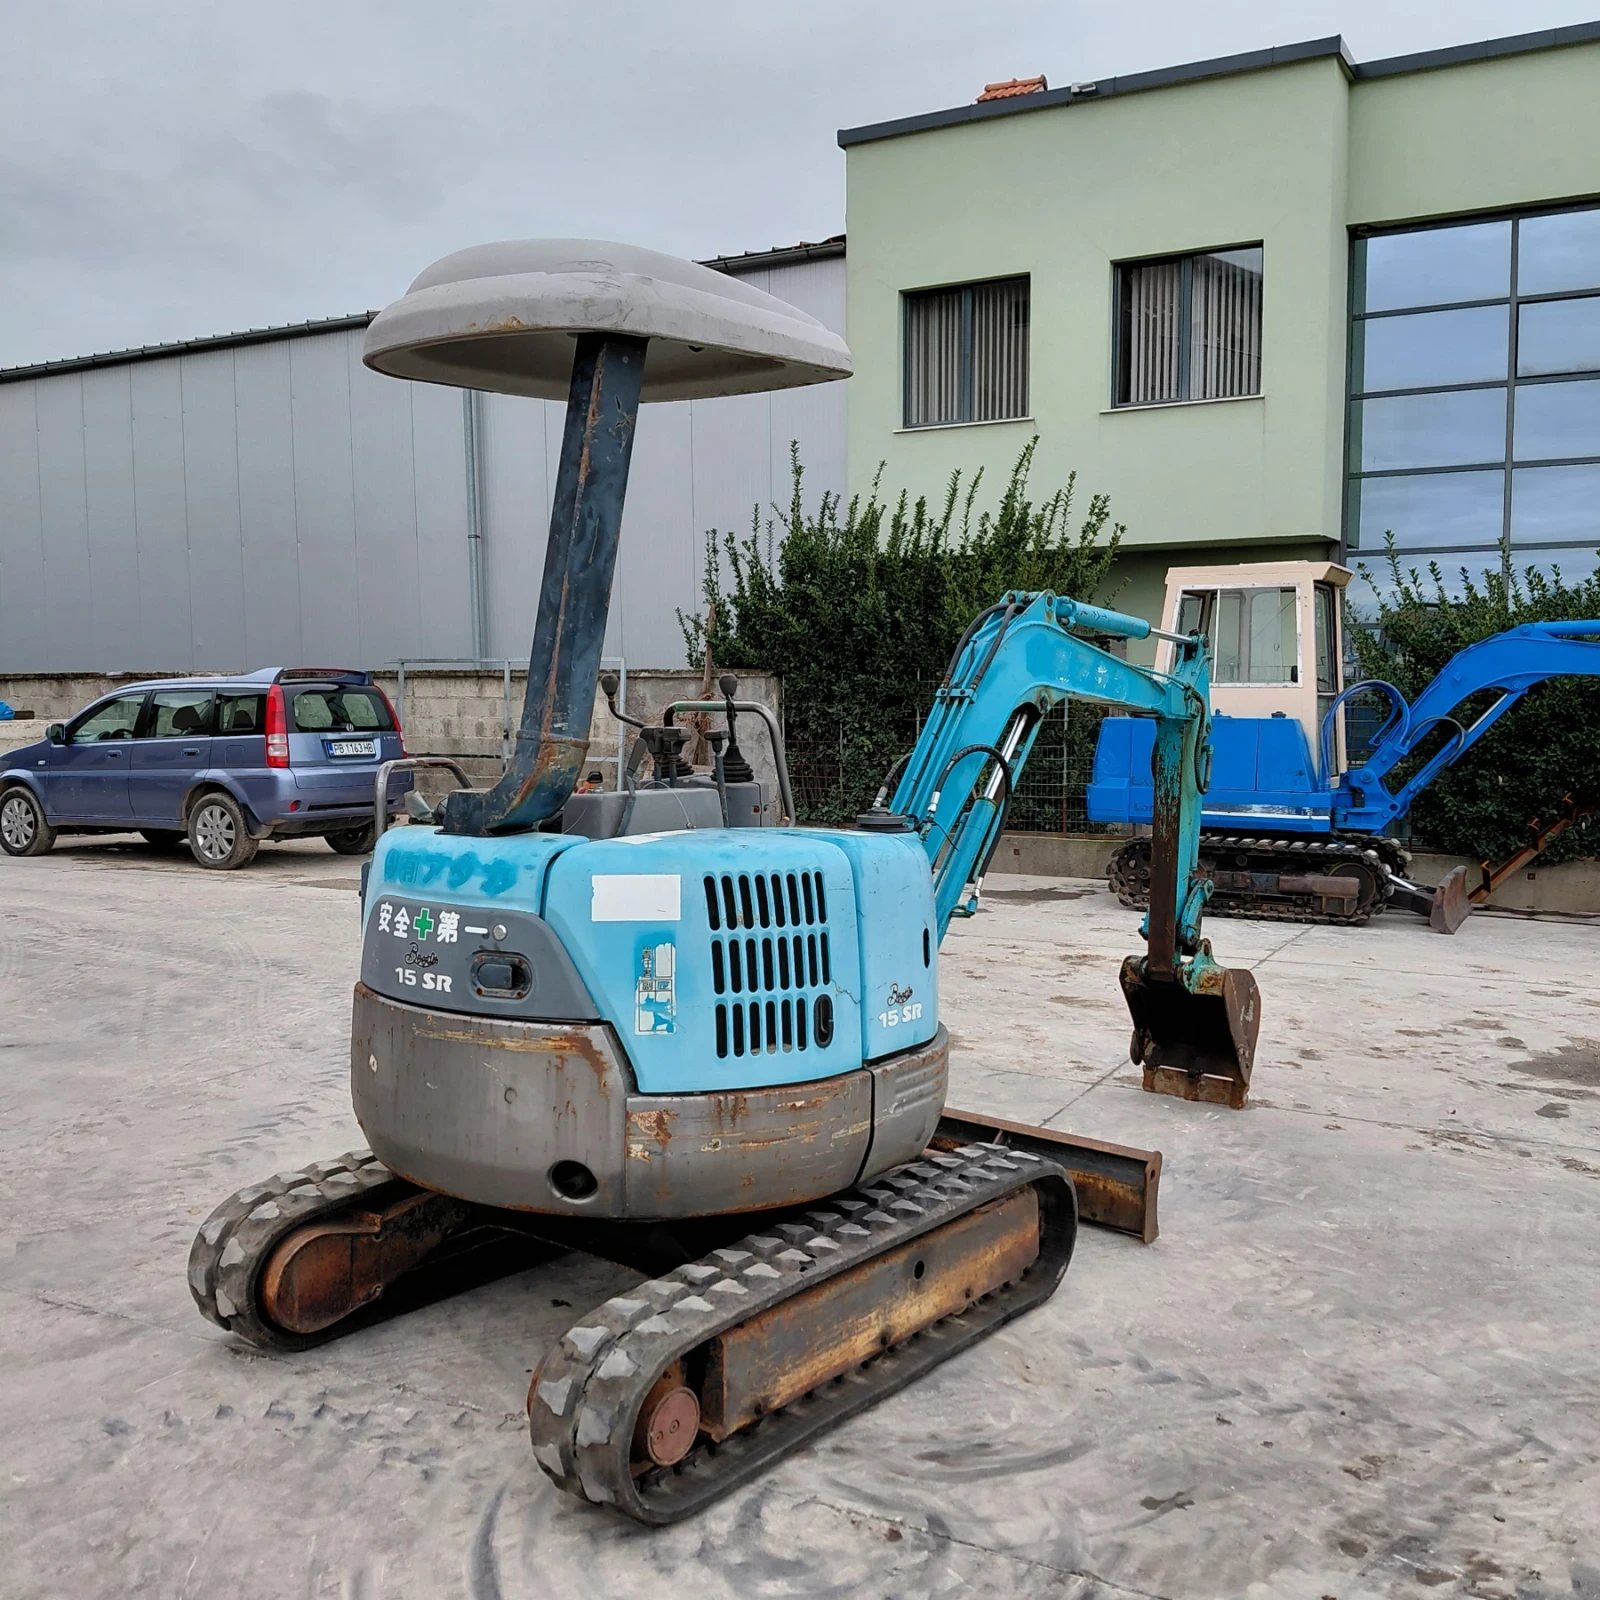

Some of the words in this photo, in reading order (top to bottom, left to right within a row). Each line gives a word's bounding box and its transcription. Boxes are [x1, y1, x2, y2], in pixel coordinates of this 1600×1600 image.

[394, 967, 417, 986] 15
[422, 972, 453, 993] SR
[878, 1009, 899, 1029] 15
[902, 1002, 923, 1023] SR
